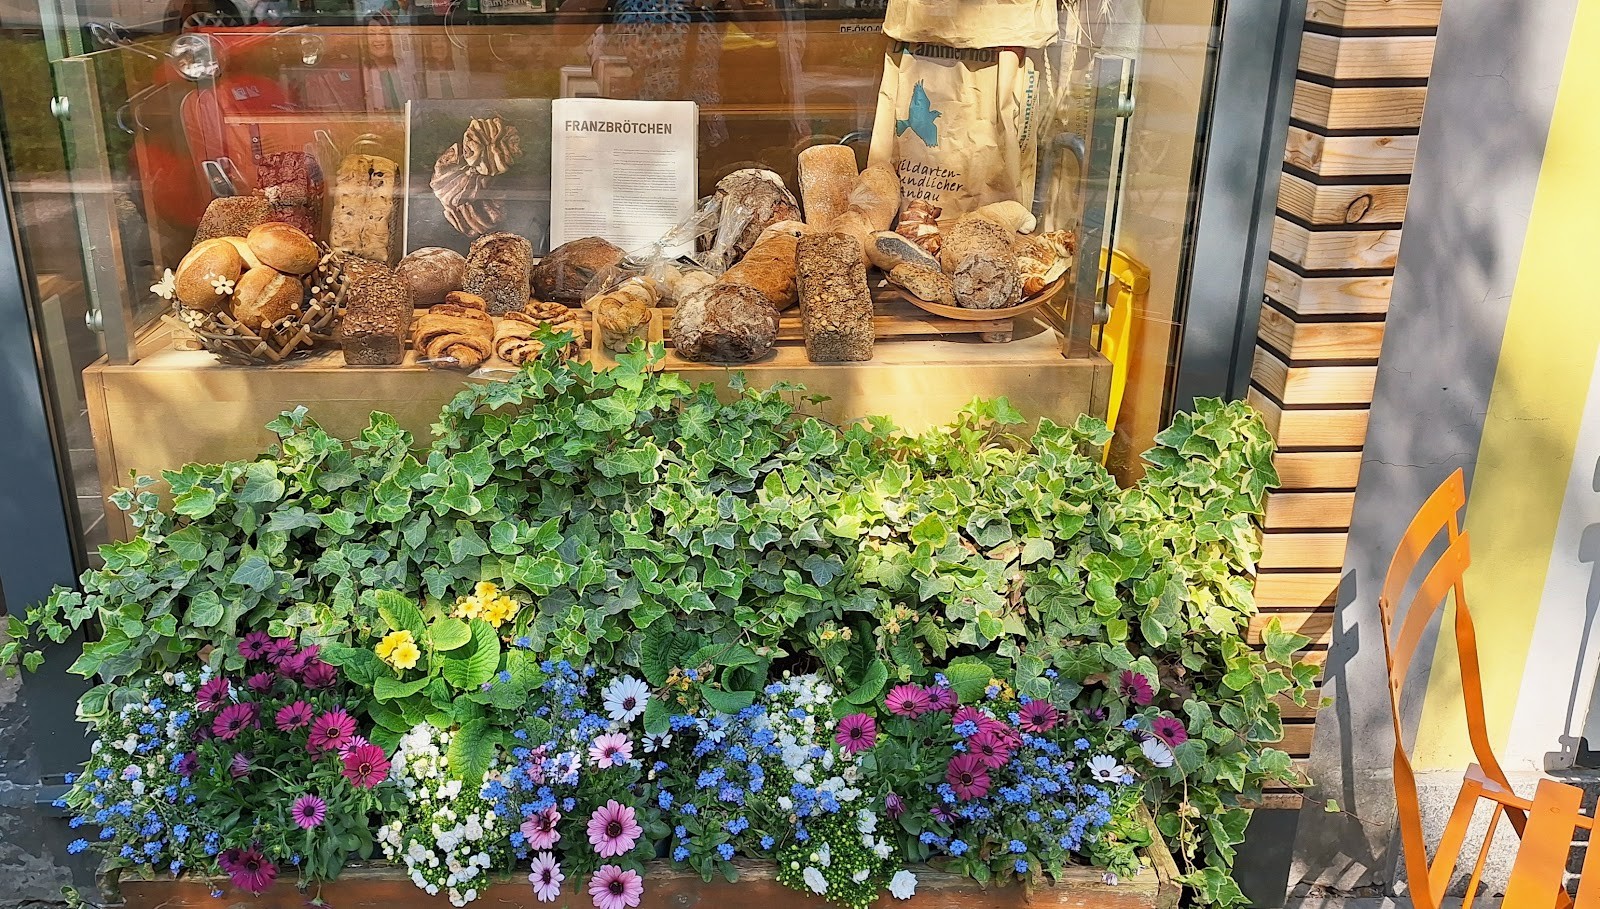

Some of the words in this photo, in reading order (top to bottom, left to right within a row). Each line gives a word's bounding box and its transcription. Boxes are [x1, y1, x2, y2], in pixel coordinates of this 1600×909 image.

[840, 24, 883, 33] DE-ÖKO-0
[565, 119, 672, 135] FRANZBRÖTCHEN
[898, 159, 961, 178] ildarten-
